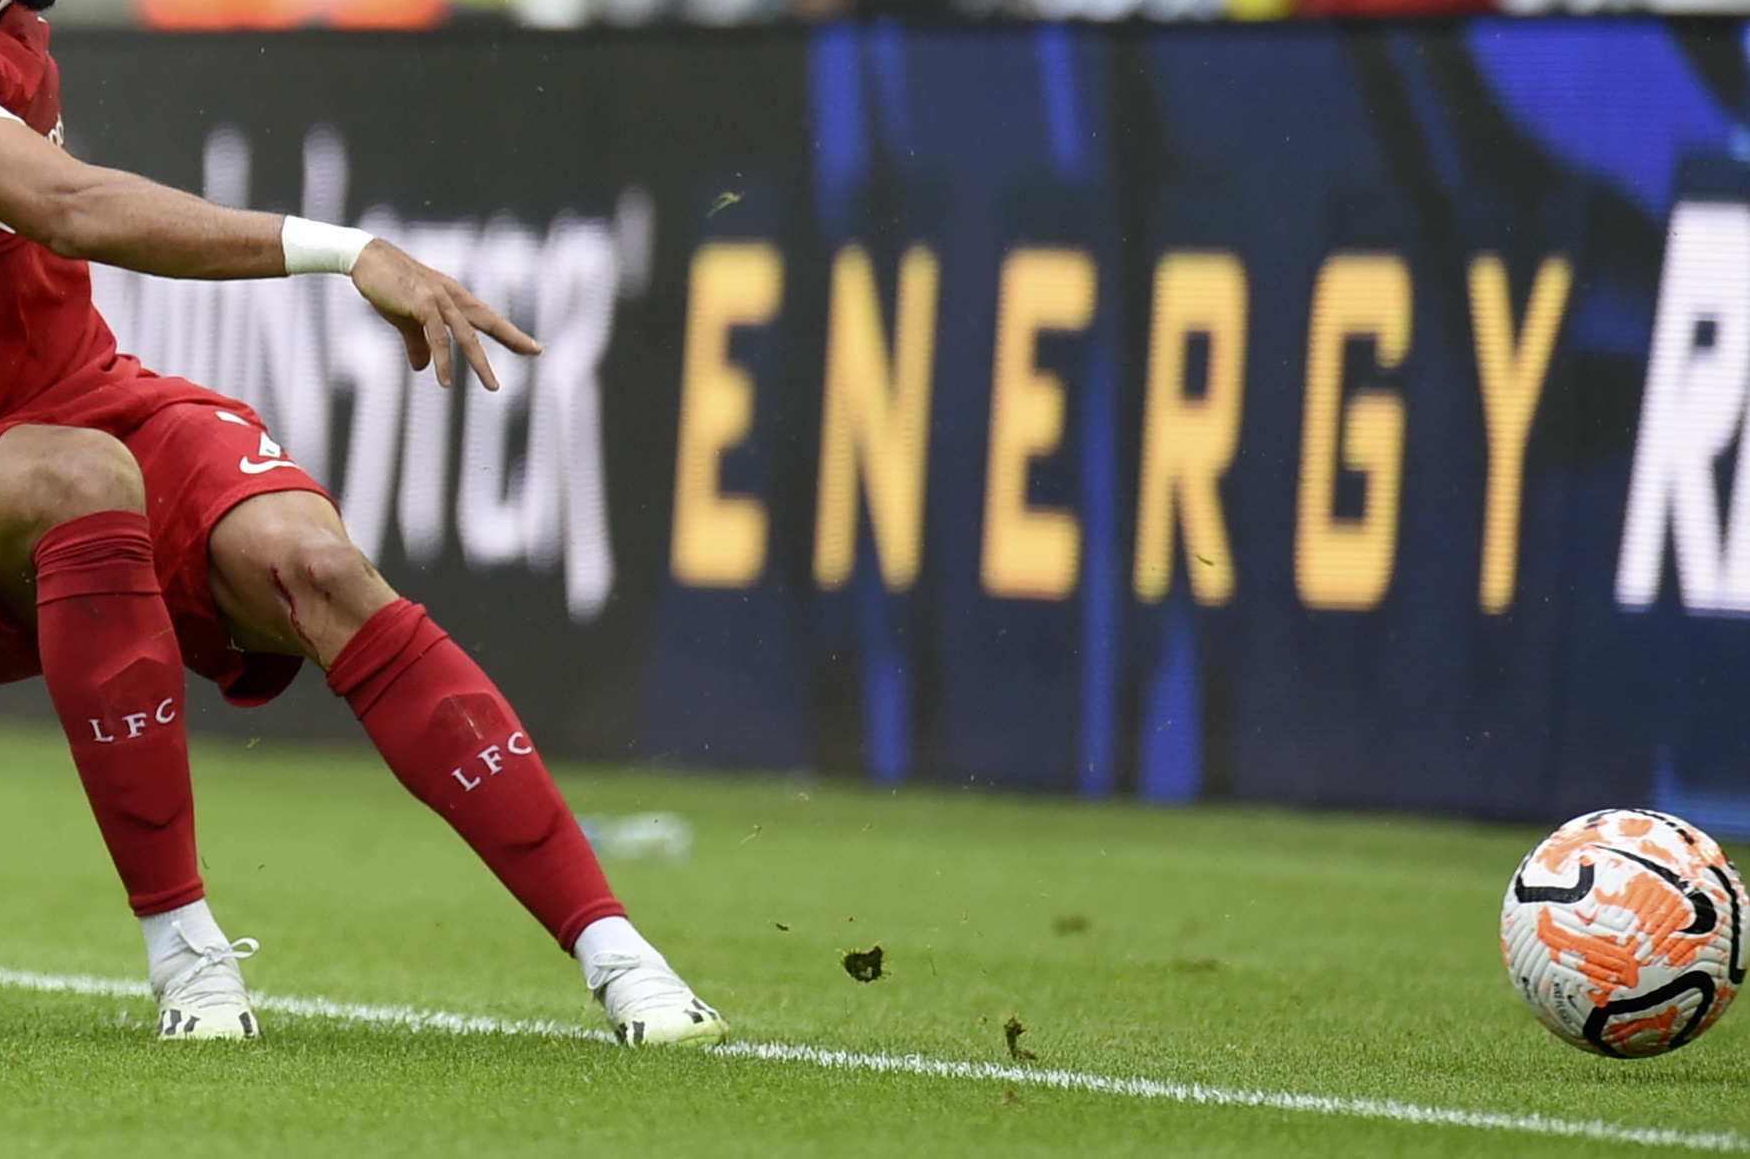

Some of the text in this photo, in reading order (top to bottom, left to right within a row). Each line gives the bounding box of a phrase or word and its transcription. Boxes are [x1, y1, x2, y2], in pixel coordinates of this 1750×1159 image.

[670, 242, 1573, 615] ENERGY
[88, 697, 175, 743] LFC
[451, 731, 533, 792] LFC
